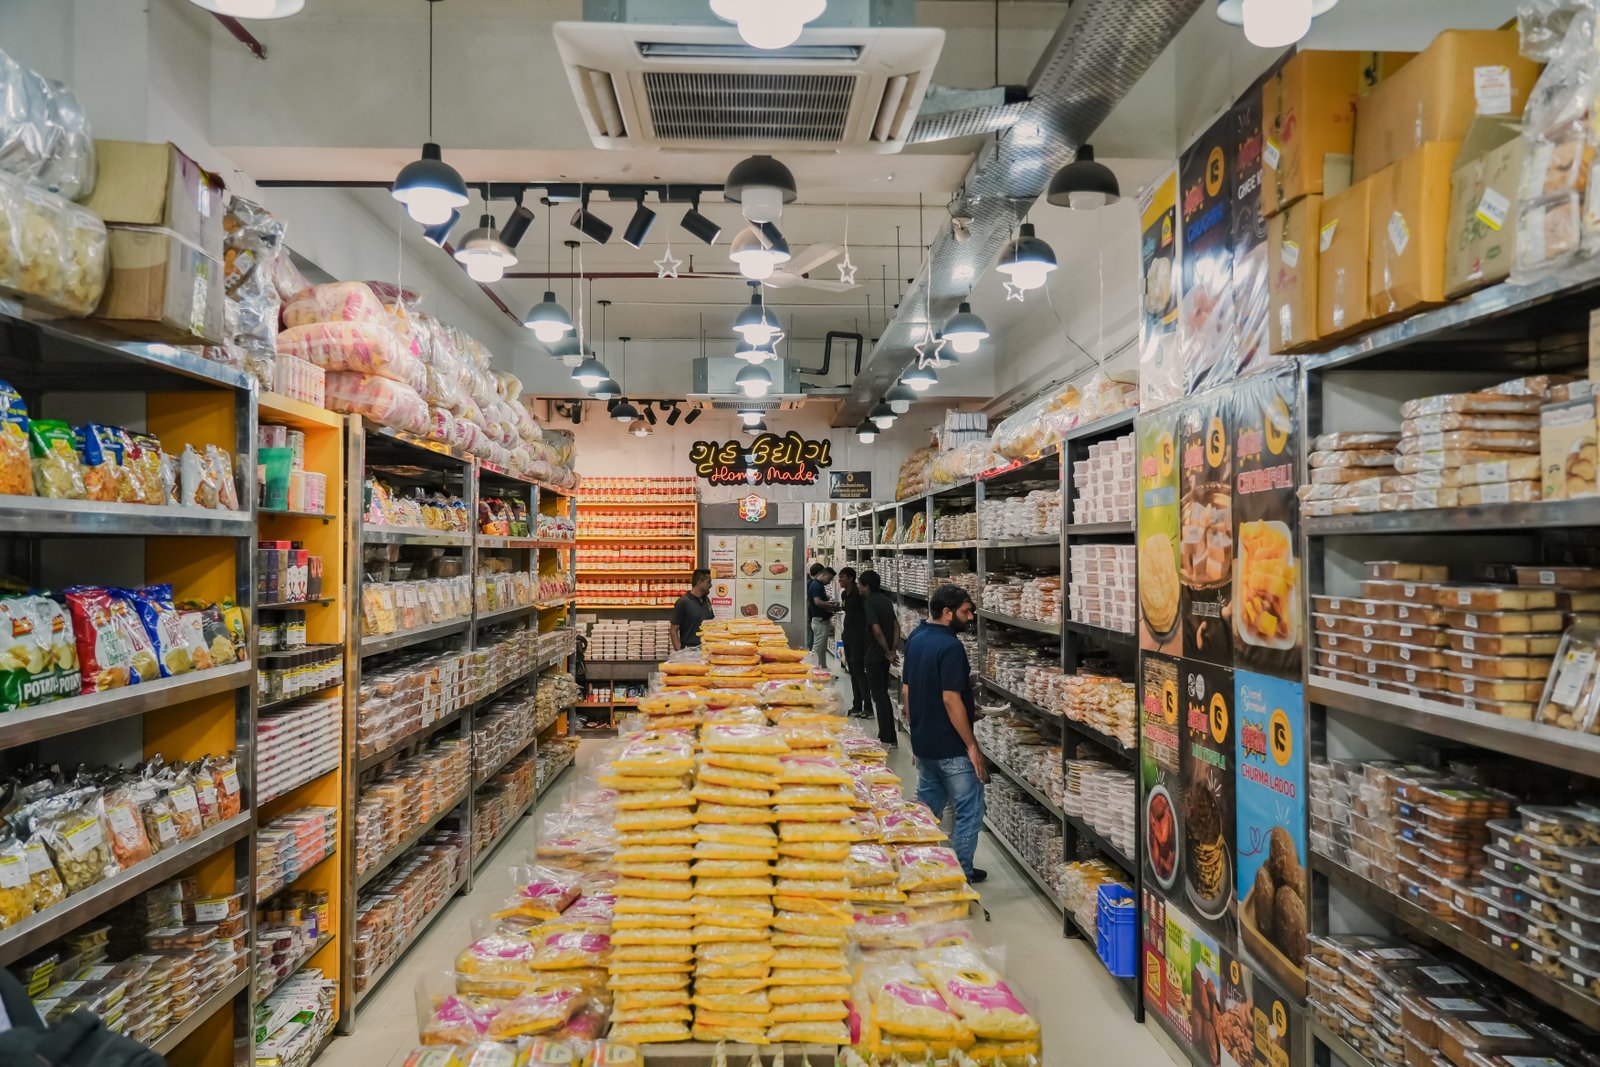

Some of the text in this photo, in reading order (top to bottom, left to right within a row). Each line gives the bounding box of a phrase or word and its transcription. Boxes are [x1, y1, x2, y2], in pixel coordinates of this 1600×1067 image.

[692, 442, 738, 474] ગૃહ
[711, 462, 817, 482] Home Made
[1241, 763, 1296, 799] CHURMA LADOO
